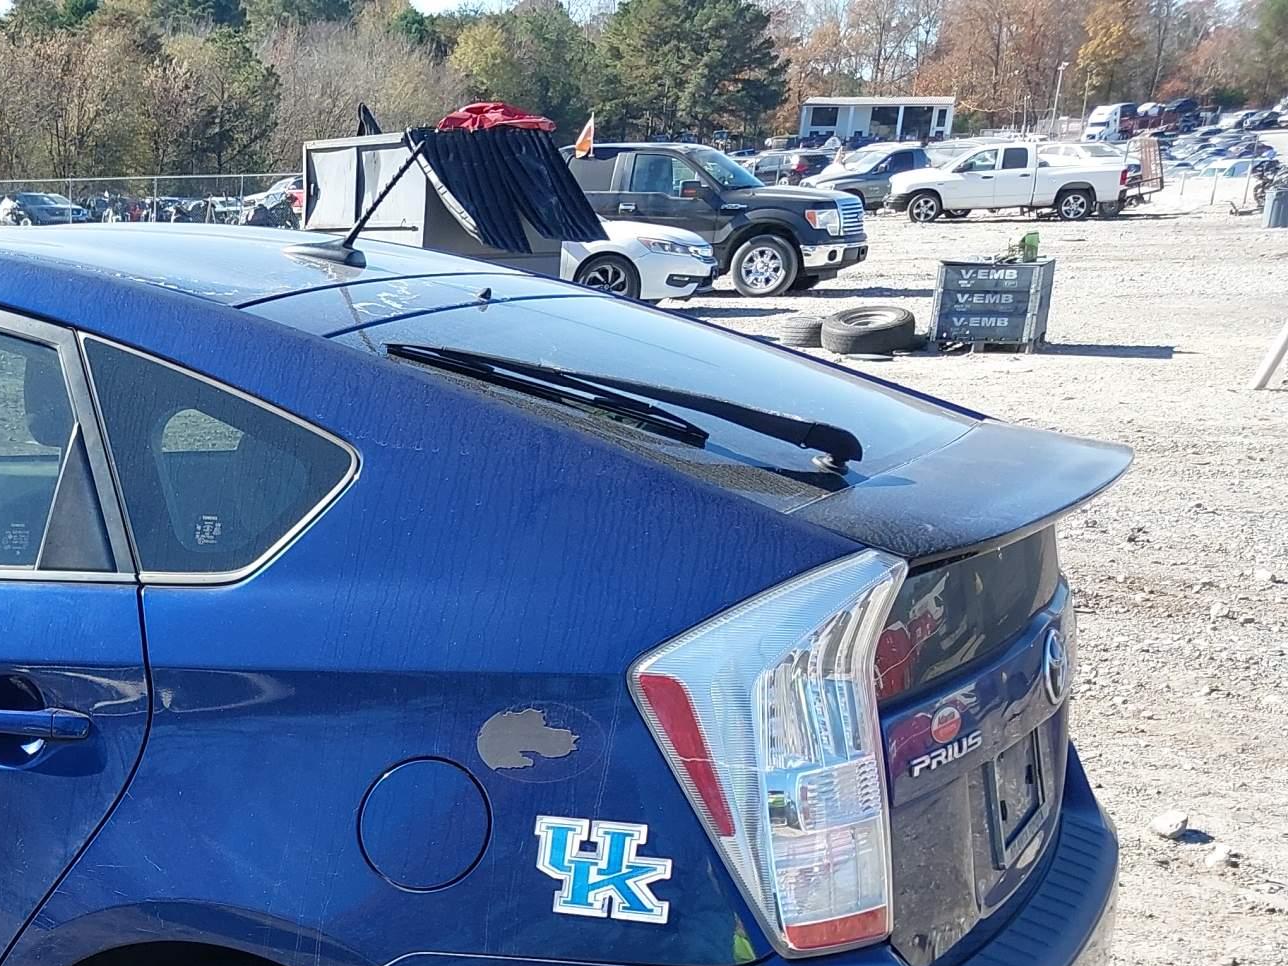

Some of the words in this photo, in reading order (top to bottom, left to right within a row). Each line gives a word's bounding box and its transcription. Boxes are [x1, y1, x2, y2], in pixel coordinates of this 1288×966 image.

[959, 268, 1018, 280] V-EMB
[956, 293, 1014, 304] V-EMB
[952, 316, 1009, 328] V-EMB
[909, 729, 983, 778] PRIUS
[534, 814, 673, 924] UK
